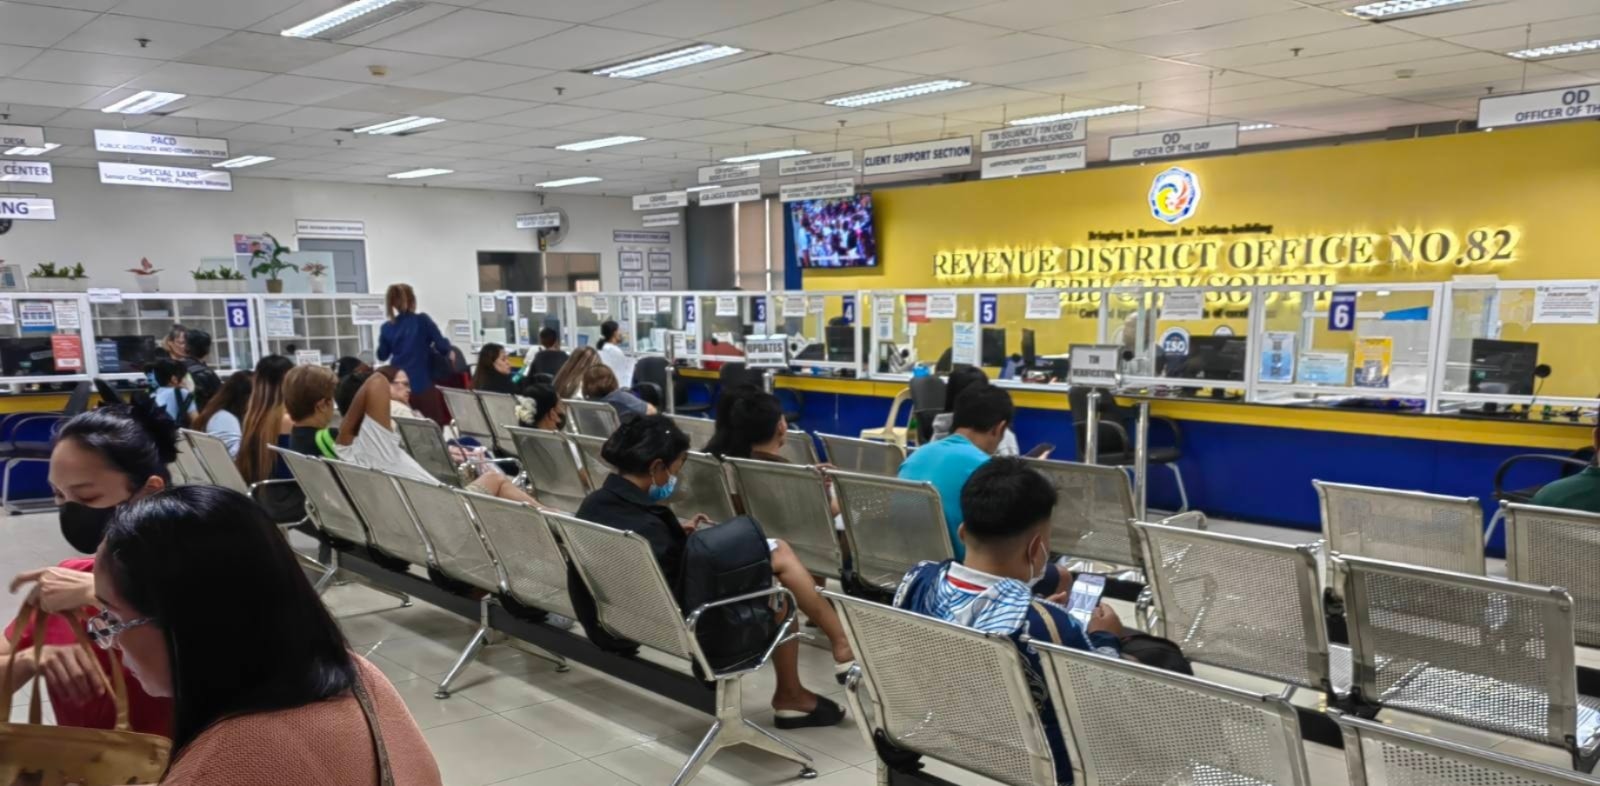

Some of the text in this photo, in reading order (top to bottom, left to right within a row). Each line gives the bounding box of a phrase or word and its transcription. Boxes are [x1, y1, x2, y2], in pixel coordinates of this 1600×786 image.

[1562, 89, 1590, 106] OD
[1515, 107, 1563, 122] OFFICER
[1566, 105, 1583, 117] OF
[151, 136, 177, 145] PACD
[1162, 133, 1181, 145] OD
[864, 145, 970, 167] CLIENT SUPPORT SECTION
[1133, 142, 1210, 158] OFFICER OF THE DAY
[3, 164, 49, 176] CENTER
[138, 167, 198, 179] SPECIAL LANE
[0, 201, 29, 215] NG
[932, 248, 1056, 276] REVENUE
[1066, 241, 1218, 273] DISTRICT
[1228, 234, 1374, 269] OFFICE
[232, 308, 245, 326] 8
[687, 305, 694, 320] 2
[758, 304, 765, 320] 3
[844, 304, 853, 321] 4
[983, 304, 993, 322] 5
[1334, 304, 1349, 328] 6
[747, 343, 783, 353] UPDATES
[1165, 340, 1186, 352] ISO
